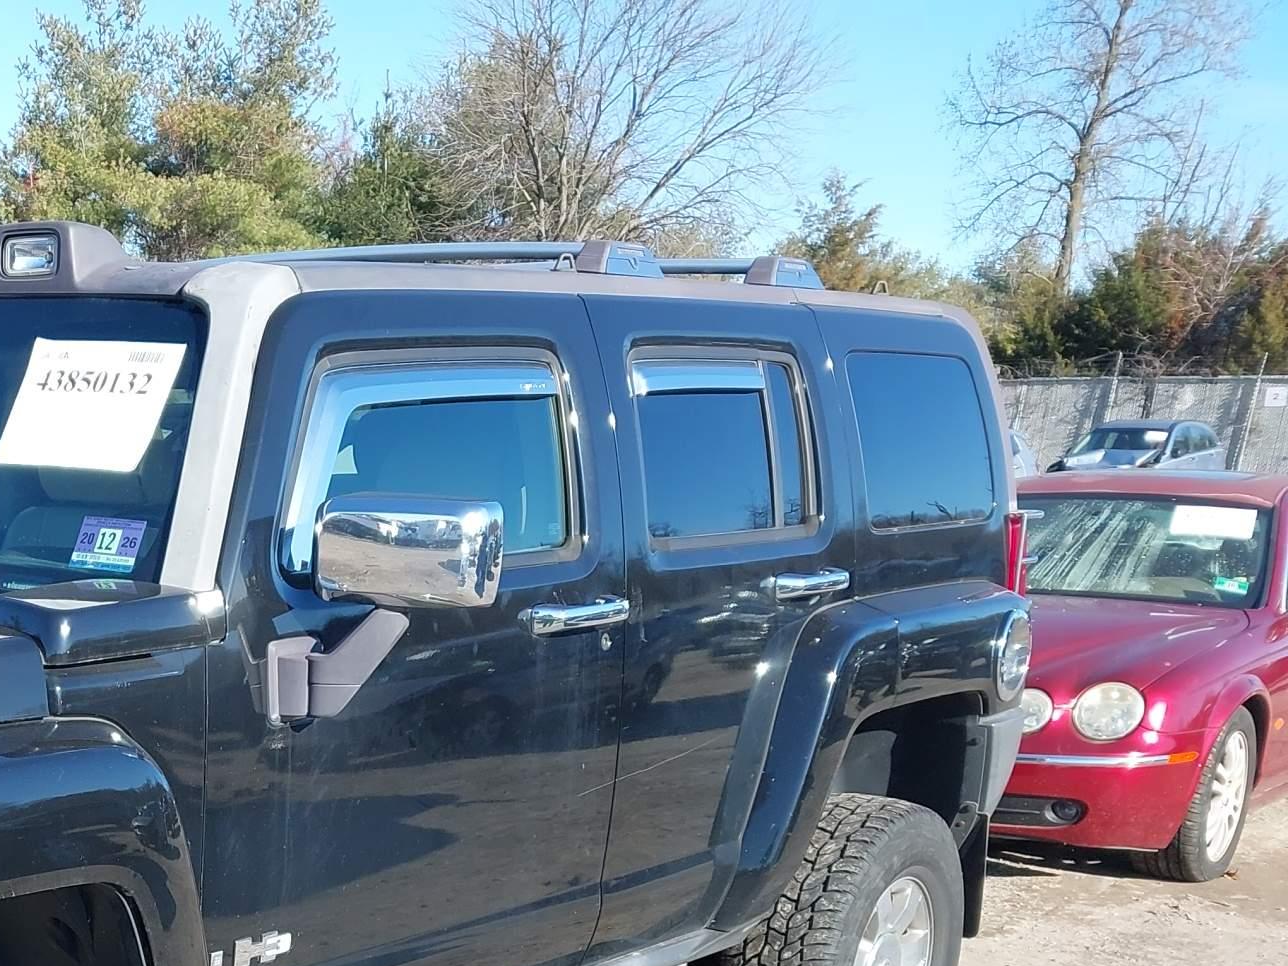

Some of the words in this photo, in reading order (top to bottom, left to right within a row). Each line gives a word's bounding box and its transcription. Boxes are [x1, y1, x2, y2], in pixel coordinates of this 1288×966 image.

[36, 368, 153, 395] 43850132
[79, 531, 96, 546] 20
[97, 531, 117, 551] 12
[120, 536, 139, 549] 26
